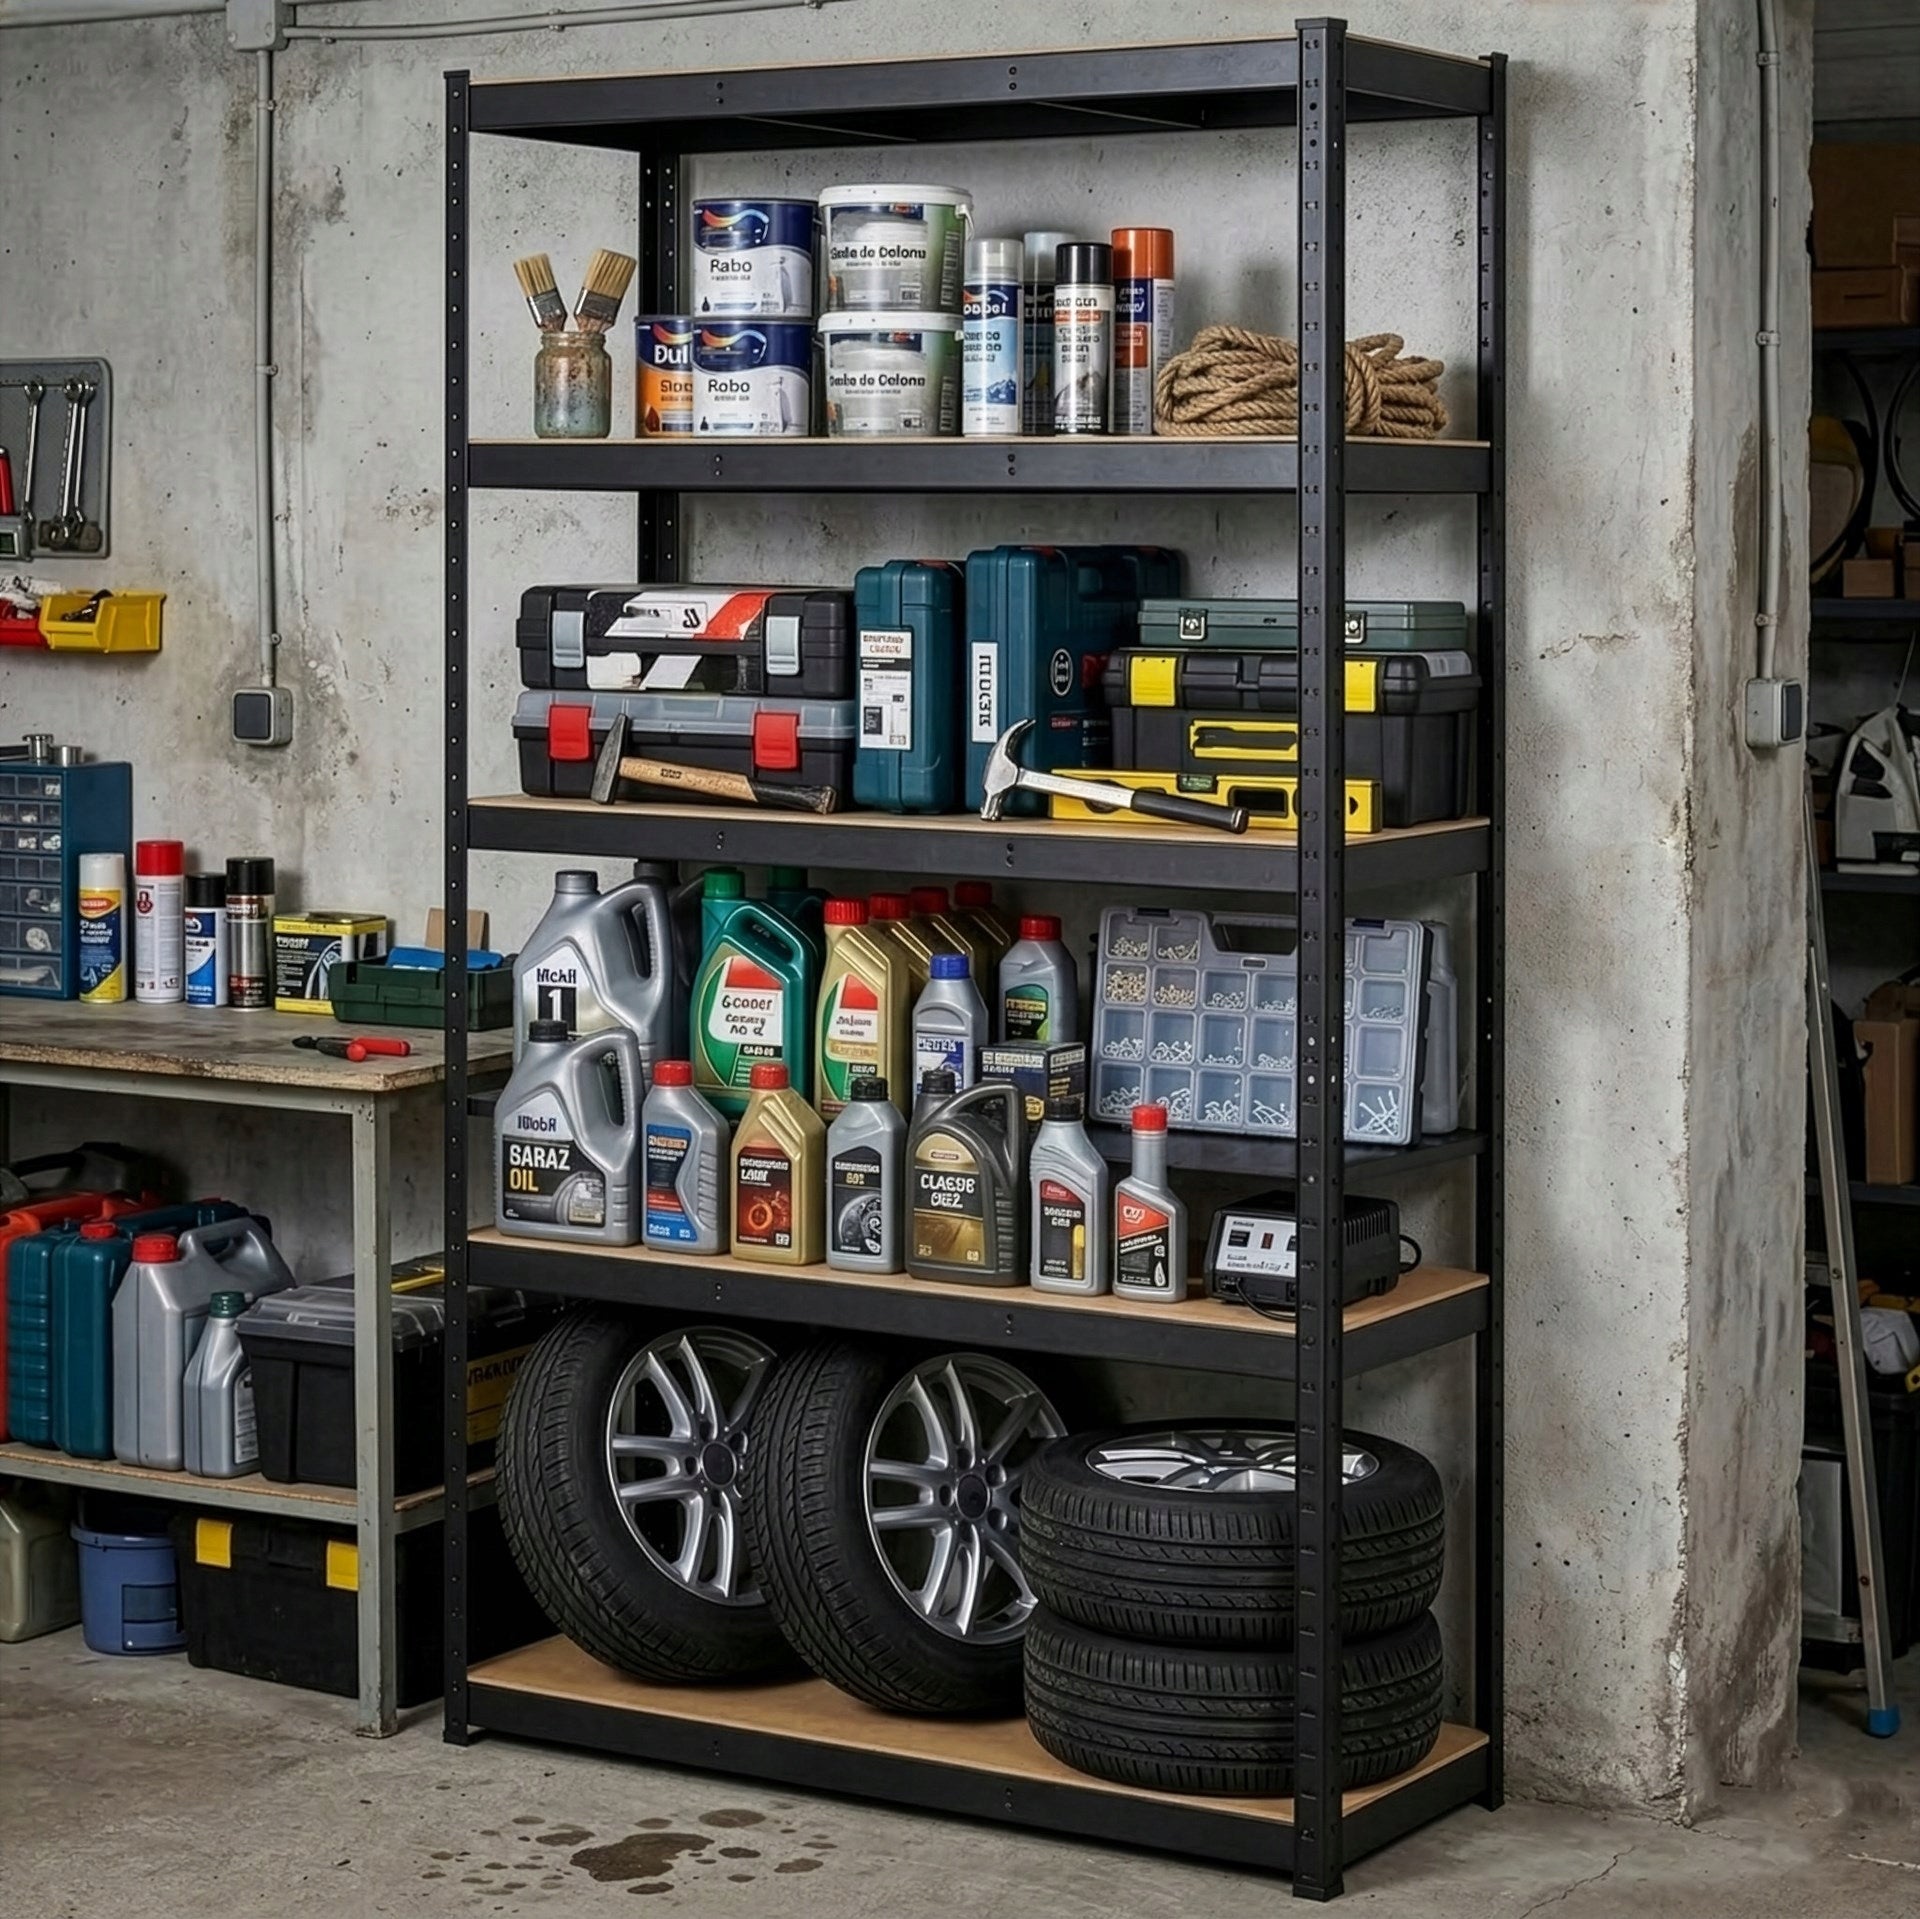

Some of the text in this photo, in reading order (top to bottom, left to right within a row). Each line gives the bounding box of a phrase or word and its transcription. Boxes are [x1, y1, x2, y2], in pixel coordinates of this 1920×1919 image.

[710, 257, 752, 273] Rabo
[654, 344, 689, 365] Dul
[708, 378, 750, 393] Robo
[509, 1168, 539, 1193] OIL
